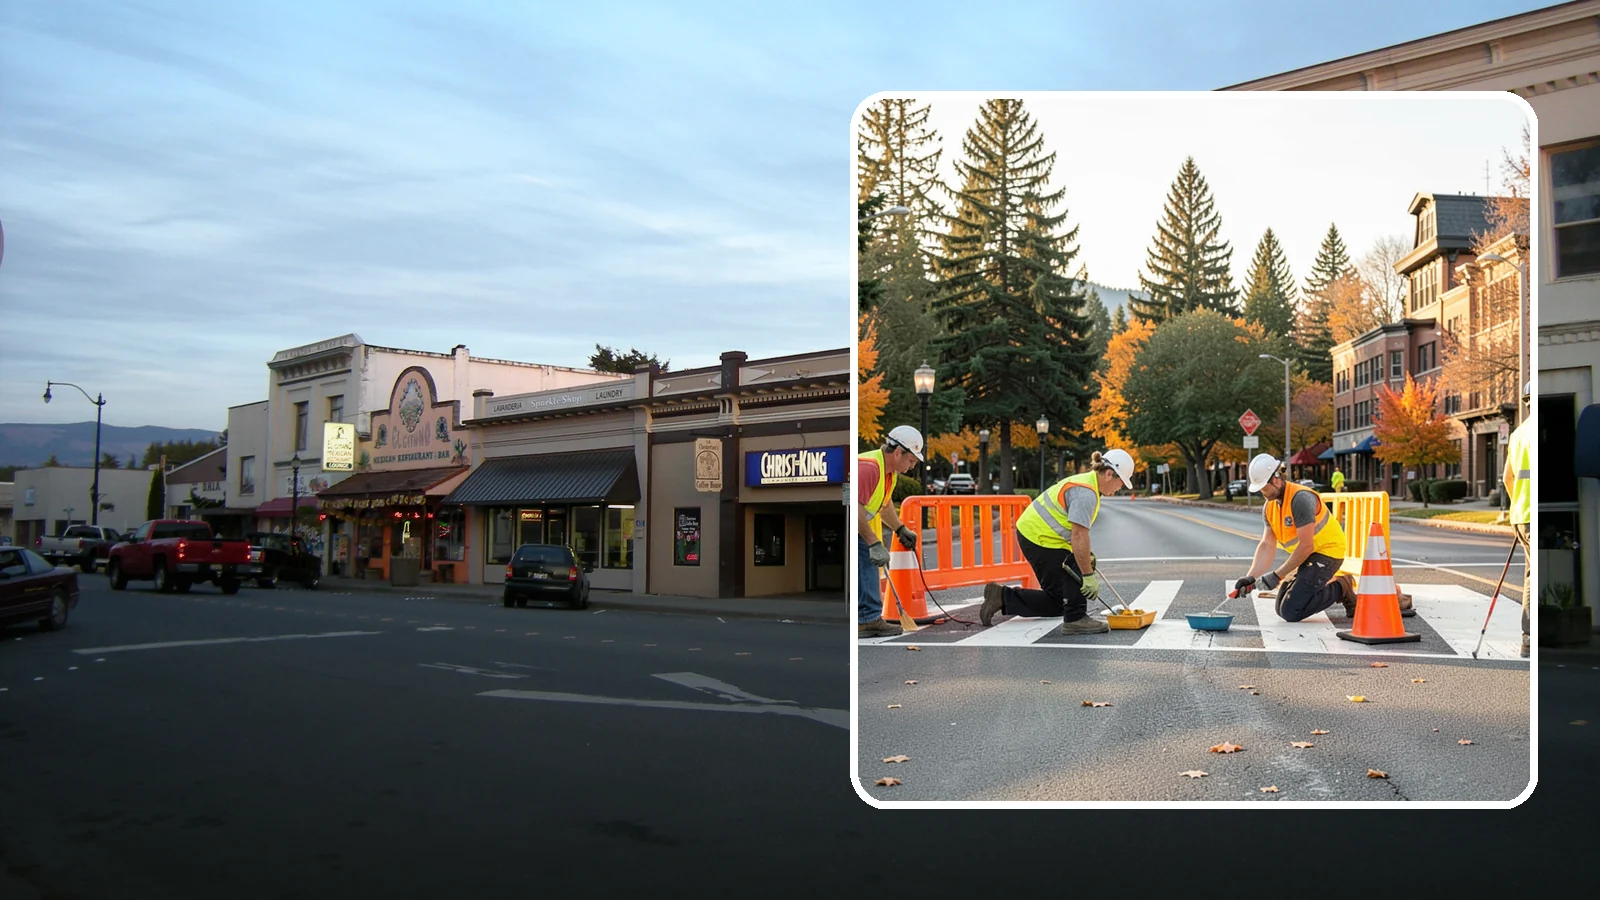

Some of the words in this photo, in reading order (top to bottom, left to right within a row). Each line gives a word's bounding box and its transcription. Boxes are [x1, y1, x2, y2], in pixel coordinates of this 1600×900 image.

[530, 395, 561, 409] Sparkle
[561, 394, 583, 405] Shop
[595, 389, 624, 400] LAUNDRY
[493, 402, 523, 413] LAVANDERIA
[373, 454, 396, 464] MEXICAN
[397, 451, 433, 462] RESTAURANT
[437, 450, 450, 459] BAR
[760, 451, 798, 478] CHRIST
[798, 449, 827, 476] KING
